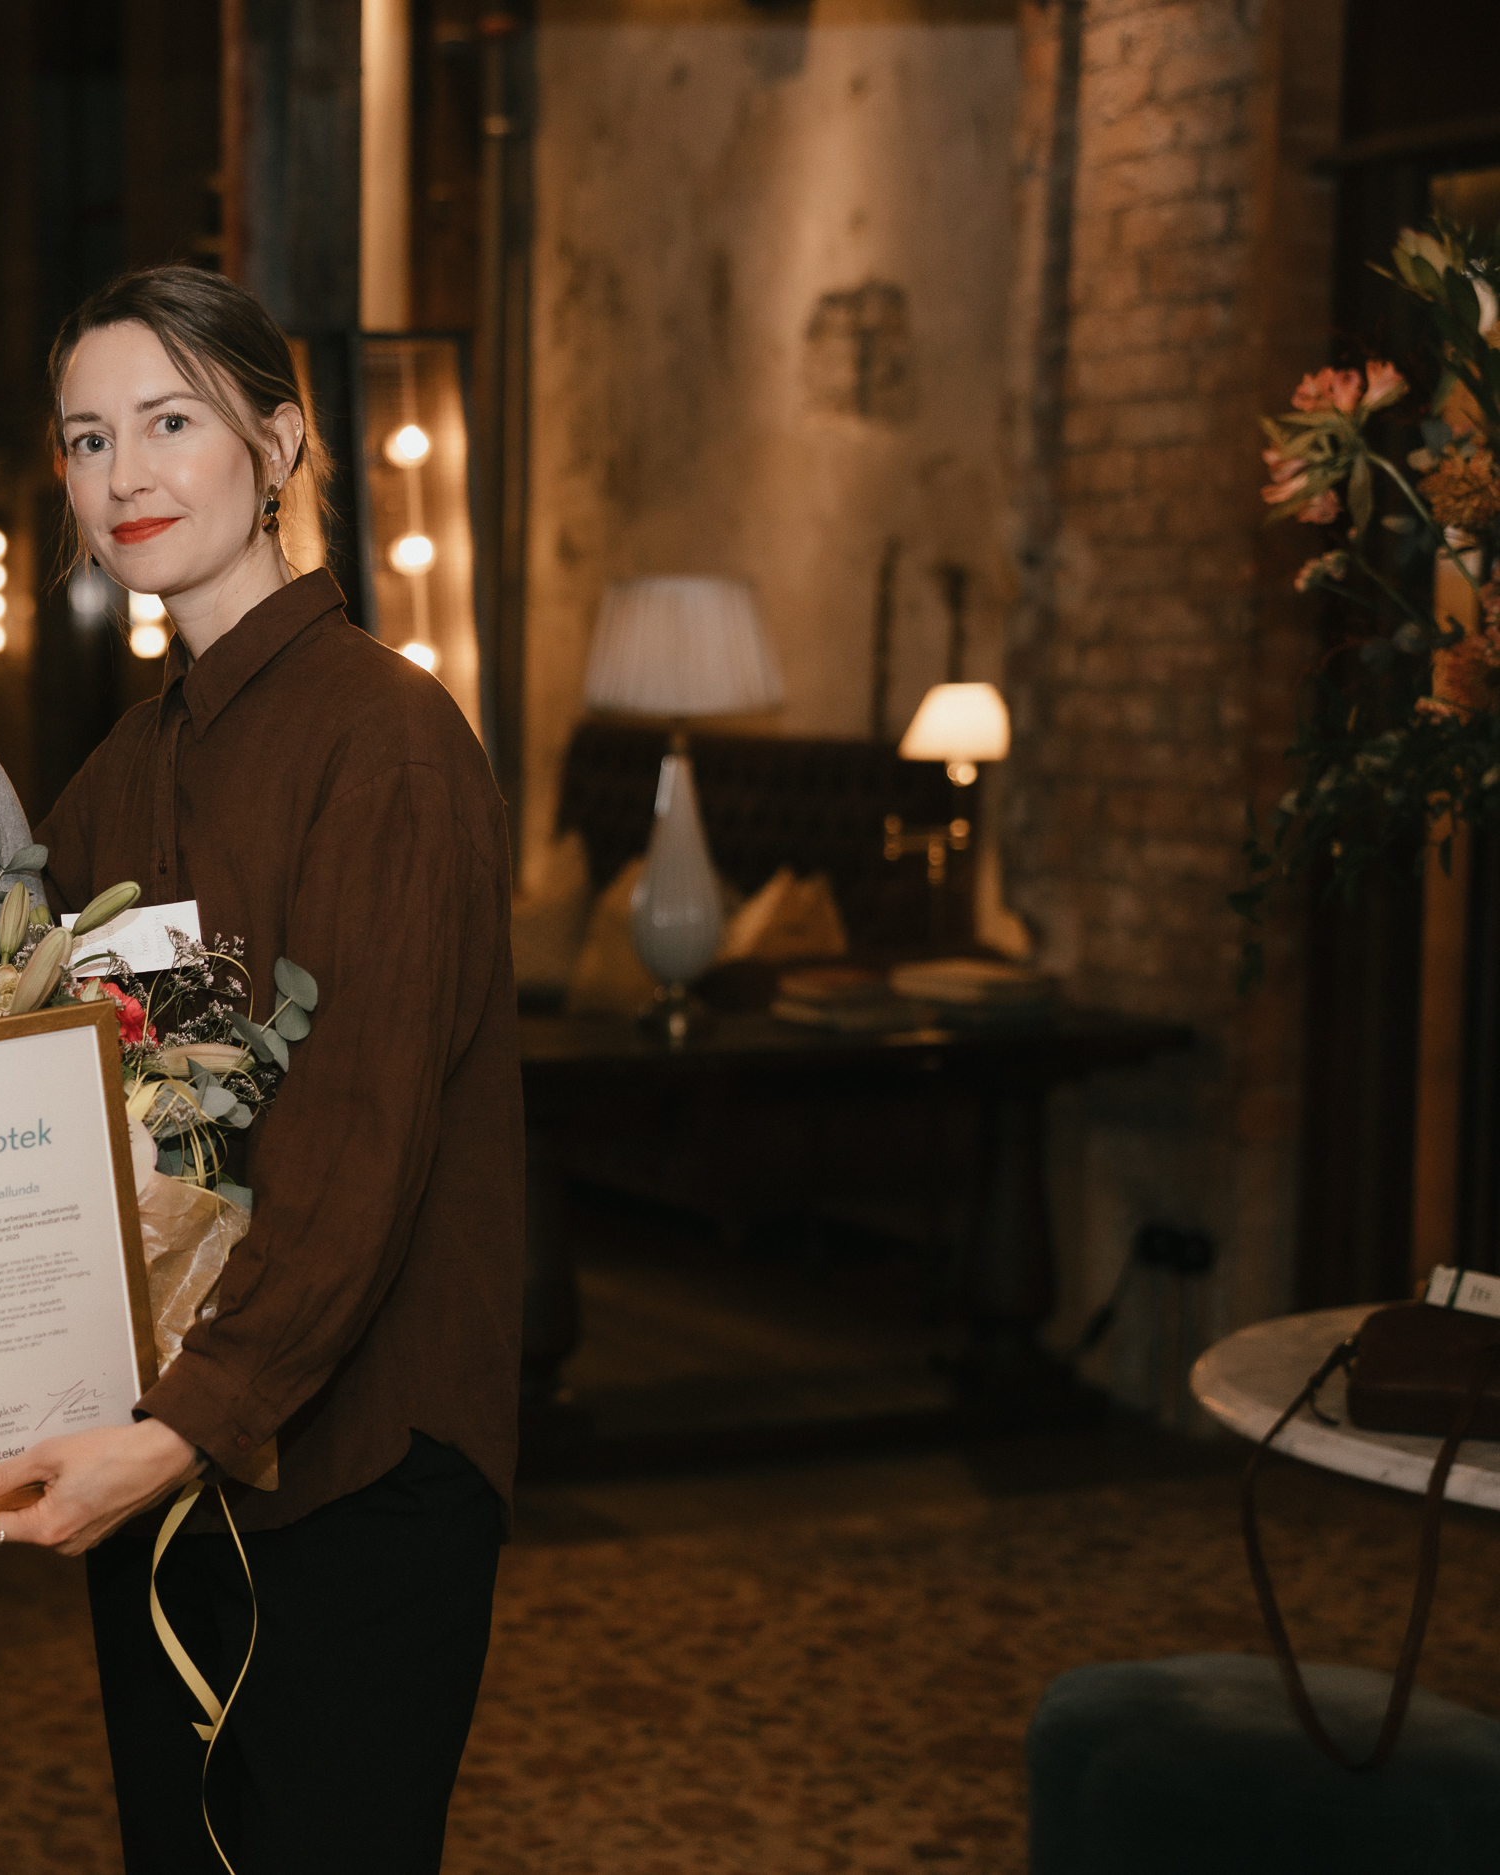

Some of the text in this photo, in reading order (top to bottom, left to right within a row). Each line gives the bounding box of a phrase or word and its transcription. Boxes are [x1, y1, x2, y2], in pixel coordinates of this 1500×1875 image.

[41, 1204, 79, 1216] arbetsmiljö
[12, 1222, 33, 1230] starka
[34, 1217, 60, 1226] resultat
[61, 1212, 81, 1221] enligt
[4, 1232, 20, 1241] 2025
